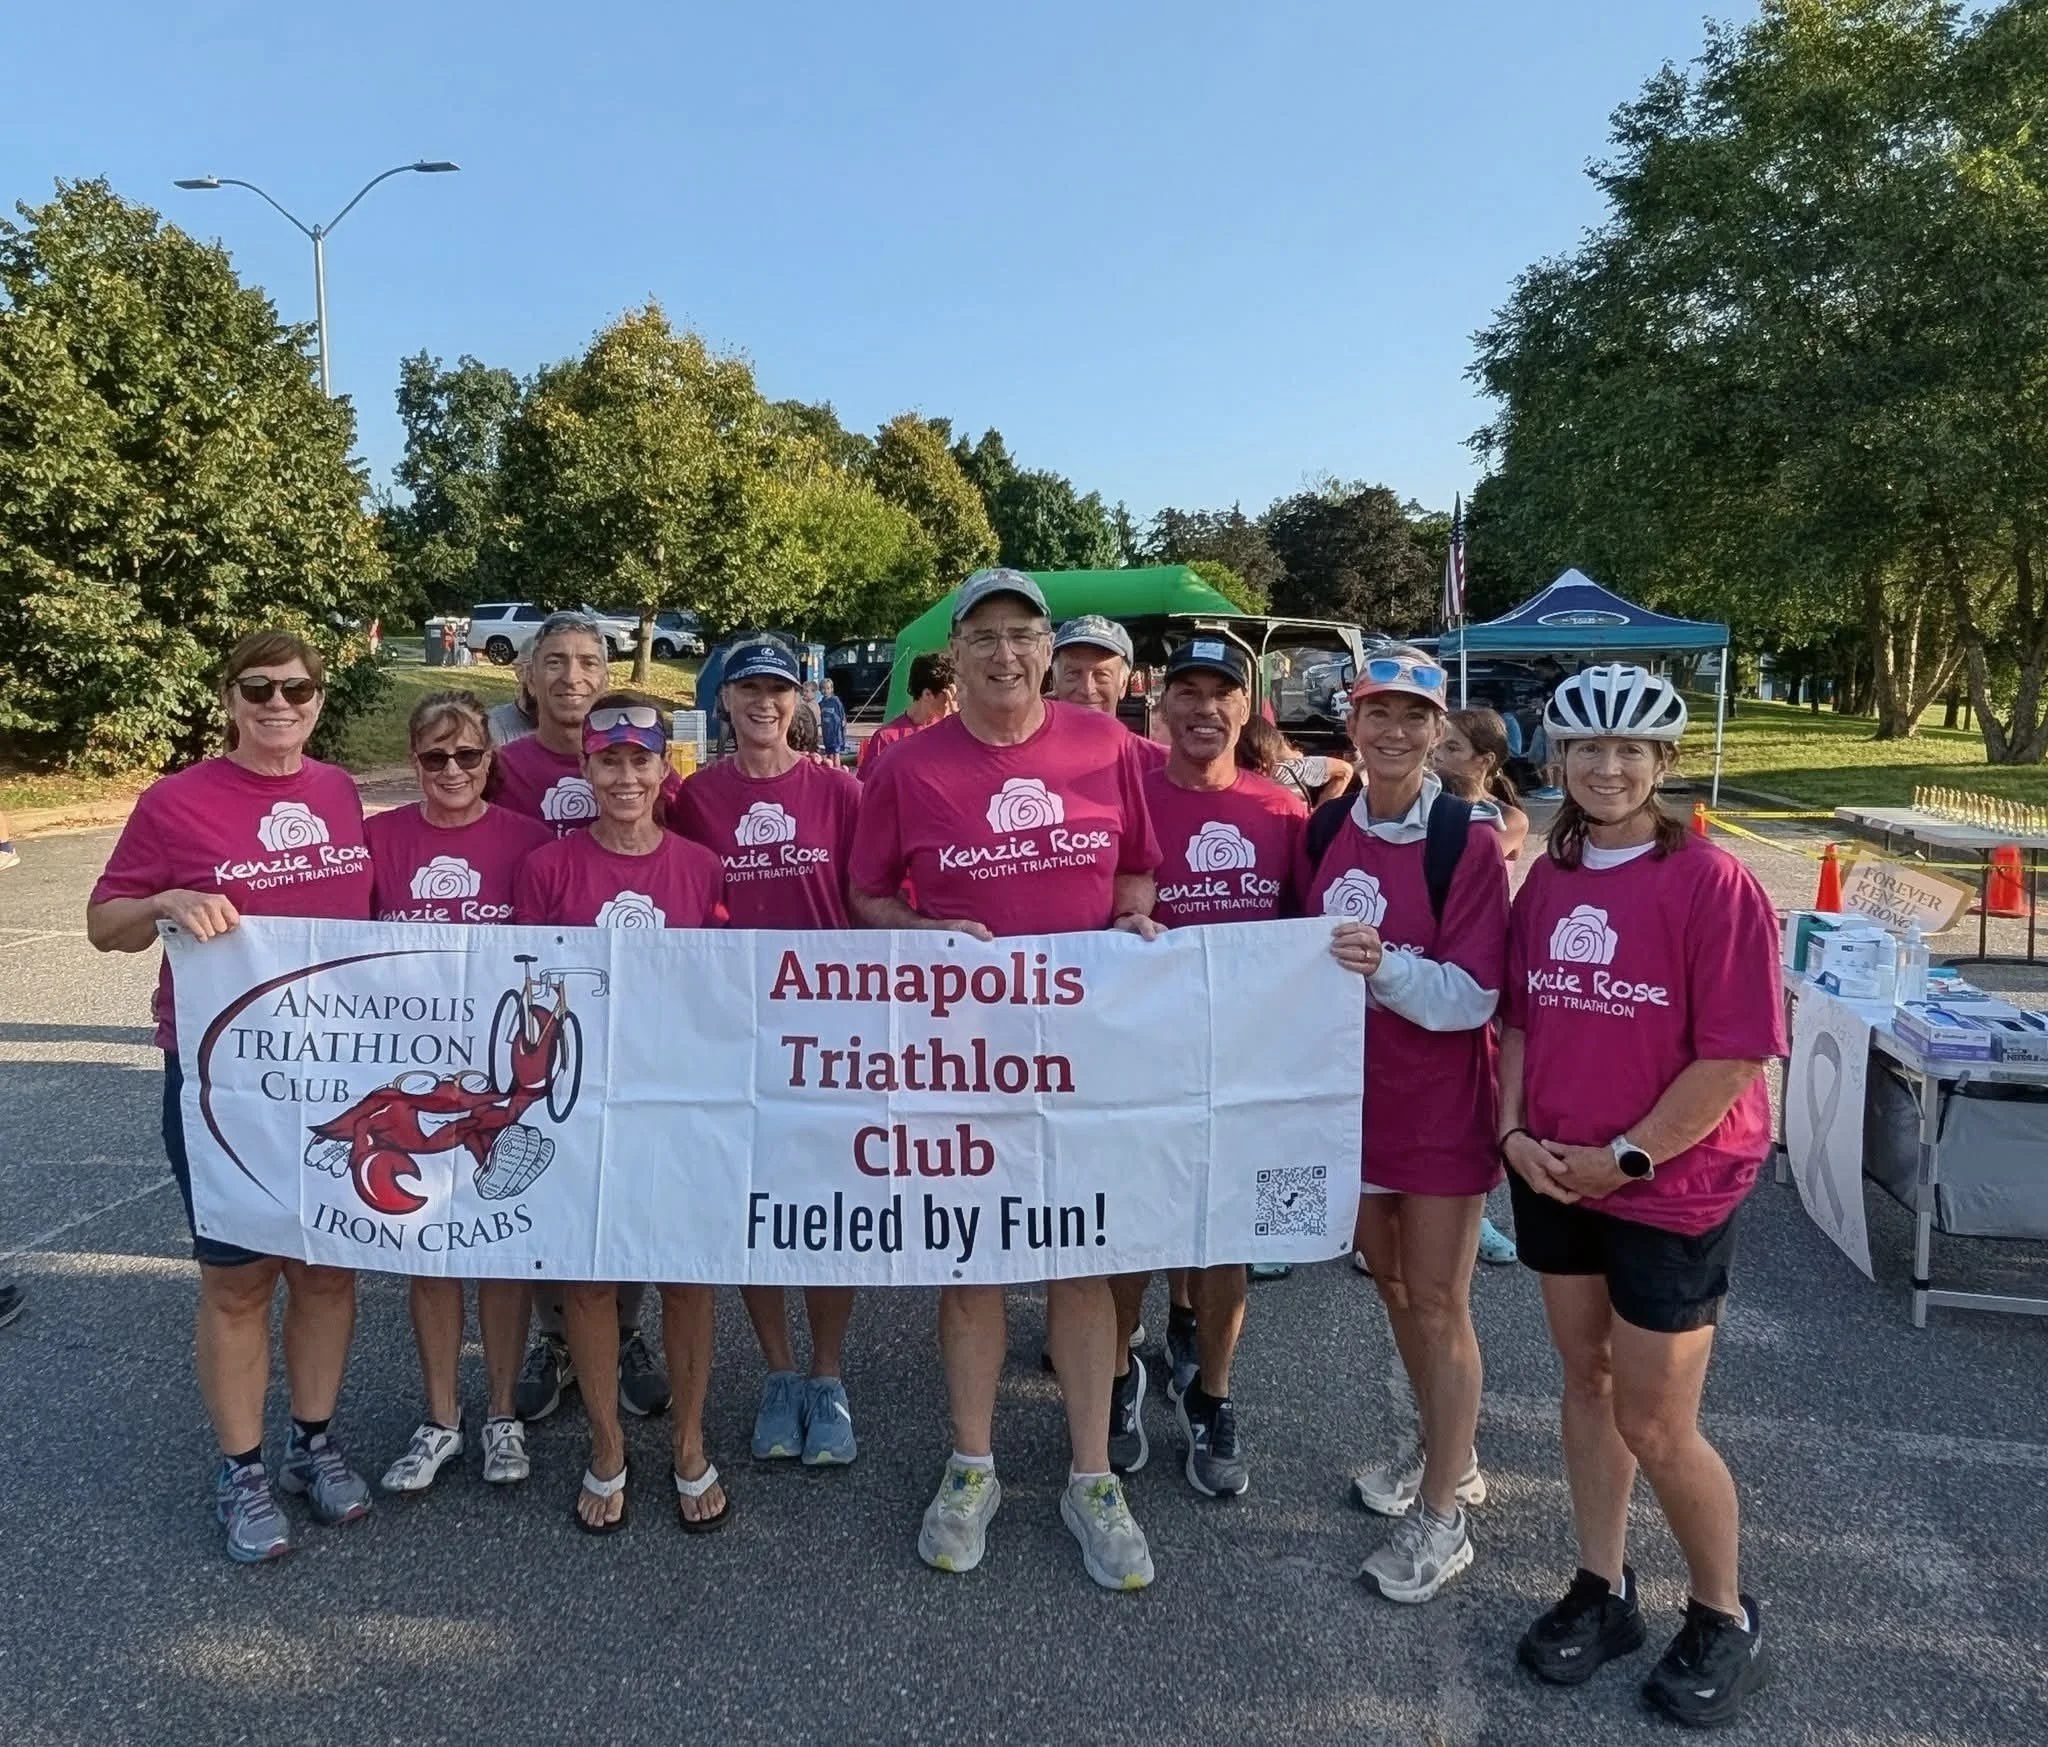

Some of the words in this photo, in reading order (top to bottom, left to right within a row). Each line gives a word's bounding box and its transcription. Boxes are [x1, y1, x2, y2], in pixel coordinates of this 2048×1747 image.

[721, 849, 772, 869] nzie
[780, 844, 830, 865] Rose
[939, 837, 1040, 872] Kenzie
[1049, 828, 1112, 853] Rose
[969, 863, 1018, 881] YOUTH
[1022, 853, 1097, 873] TRIATHLON
[214, 852, 313, 886] Kenzie
[247, 874, 294, 891] YOUTH
[298, 862, 364, 883] TRIATHLON
[725, 871, 755, 883] OUTH
[758, 865, 814, 880] TRIATHLON
[1159, 876, 1231, 902] enzie
[1171, 901, 1211, 914] YOUTH
[1214, 898, 1273, 911] TRIATHLON
[1863, 866, 1942, 912] FOREVER
[1847, 894, 1913, 929] STRONG
[770, 950, 1085, 1018] Annapolis
[1593, 970, 1671, 1007] Rose
[272, 986, 475, 1022] ANNAPOLIS
[1562, 996, 1636, 1019] TRIATHLON
[230, 1028, 476, 1066] TRIATHLON
[781, 1035, 1076, 1094] Triathlon
[260, 1071, 350, 1103] CLUB
[854, 1124, 995, 1177] Club
[312, 1202, 407, 1252] IRON
[417, 1203, 533, 1252] CRABS
[748, 1191, 903, 1252] Fueled
[924, 1193, 981, 1263] by
[1000, 1192, 1106, 1251] Fun!
